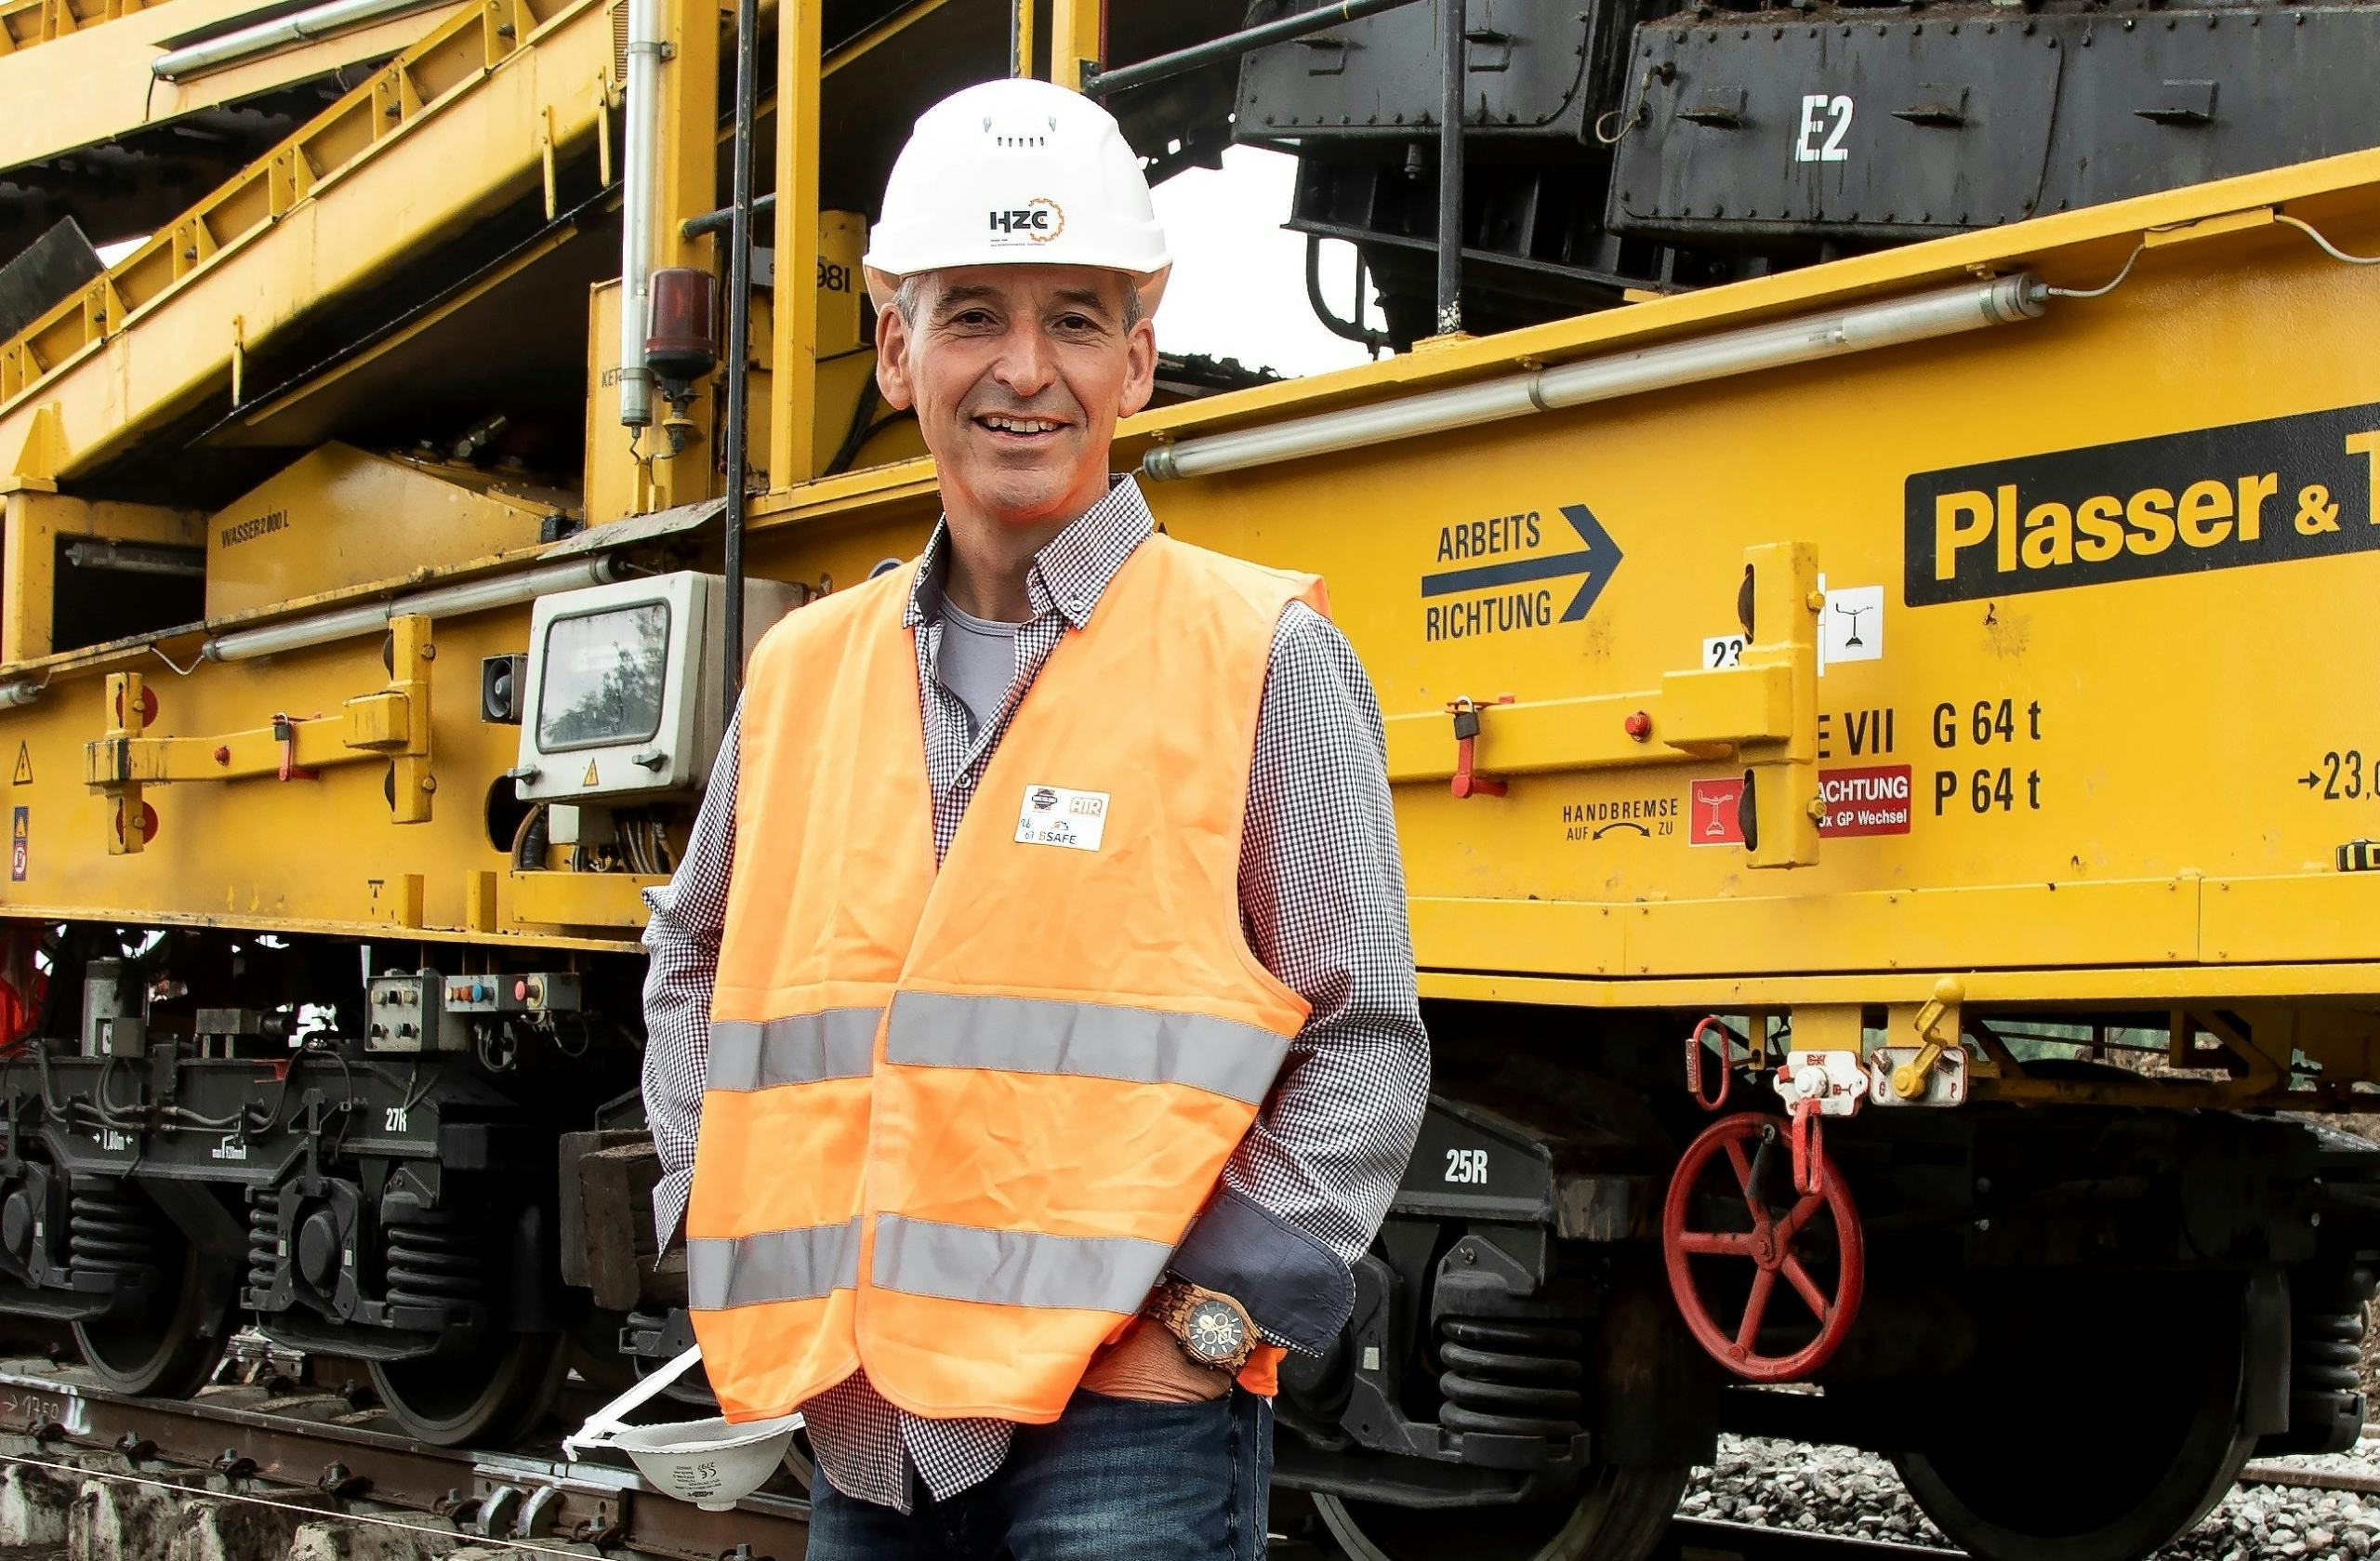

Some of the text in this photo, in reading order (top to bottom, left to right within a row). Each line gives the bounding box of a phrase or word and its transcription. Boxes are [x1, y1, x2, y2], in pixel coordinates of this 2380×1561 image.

[1795, 94, 1854, 162] E2
[989, 210, 1048, 233] HZC
[1437, 511, 1540, 562] ARBEITS
[1935, 471, 2278, 581] Plasser
[2294, 484, 2341, 536] &
[1427, 590, 1552, 642] RICHTUNG
[1844, 708, 1894, 756] VII
[1933, 698, 2042, 748] G 64 t
[1563, 798, 1679, 823] HANDBREMSE
[1935, 767, 2041, 816] P 64 t
[1567, 821, 1673, 840] AUF ZU
[1836, 811, 1855, 827] GP
[1858, 808, 1908, 826] Wechsel
[385, 1107, 407, 1131] 27R
[1445, 1148, 1488, 1184] 25R
